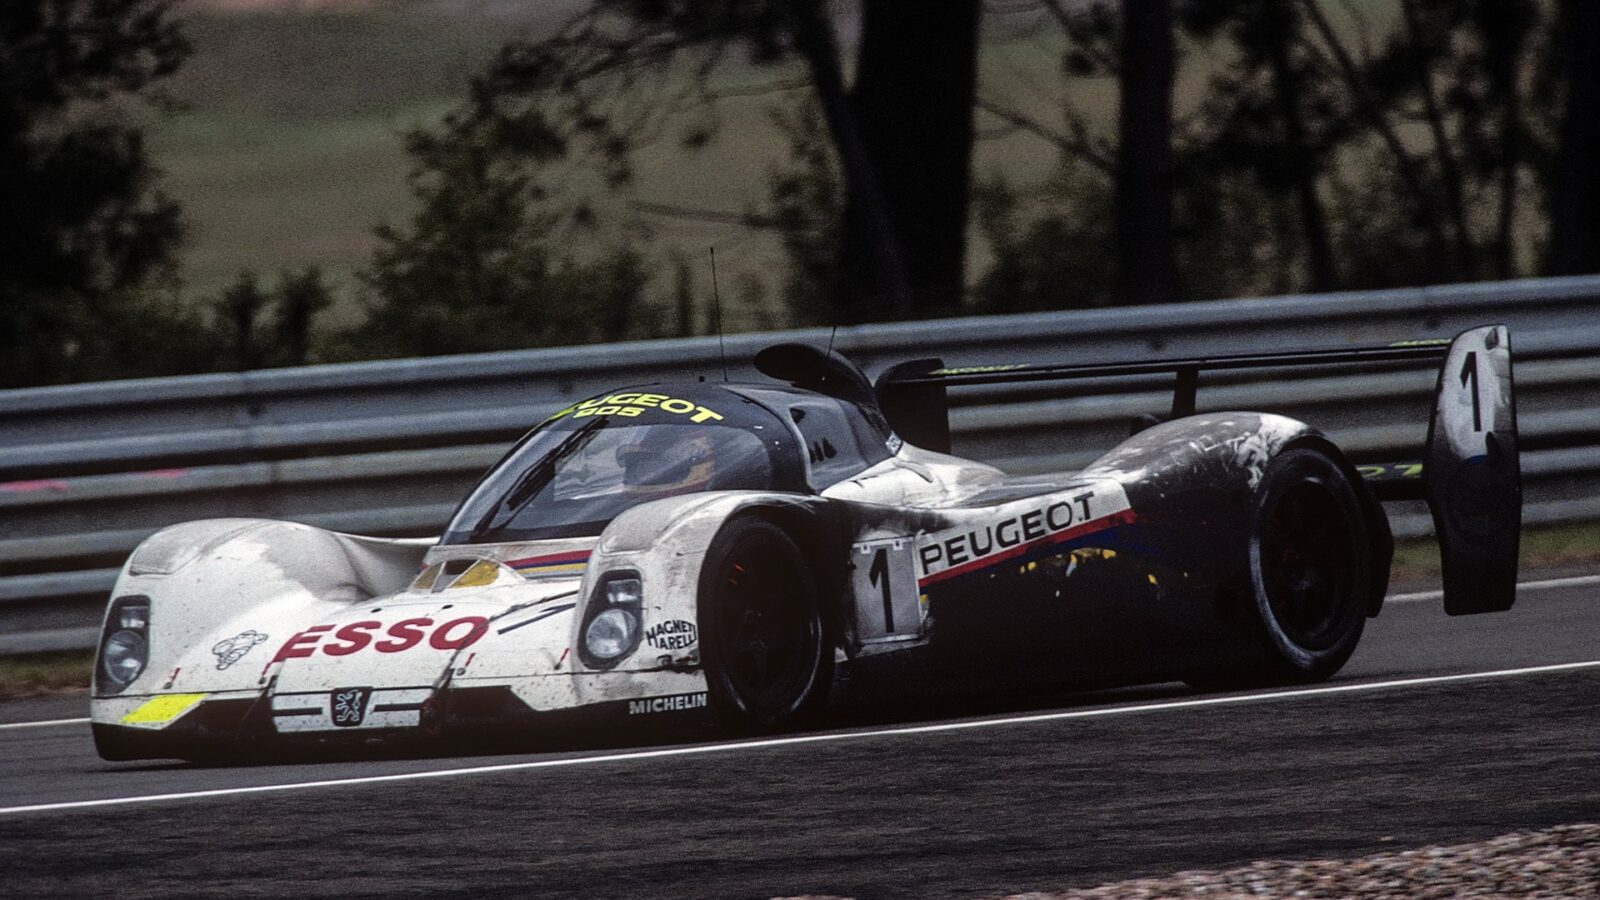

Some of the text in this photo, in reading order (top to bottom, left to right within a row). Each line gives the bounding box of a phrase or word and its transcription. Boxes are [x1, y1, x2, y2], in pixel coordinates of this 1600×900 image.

[1460, 351, 1481, 431] 1
[919, 491, 1095, 575] PEUGEOT
[869, 548, 894, 633] 1
[271, 616, 489, 662] ESSO
[628, 693, 707, 715] MICHELIN
